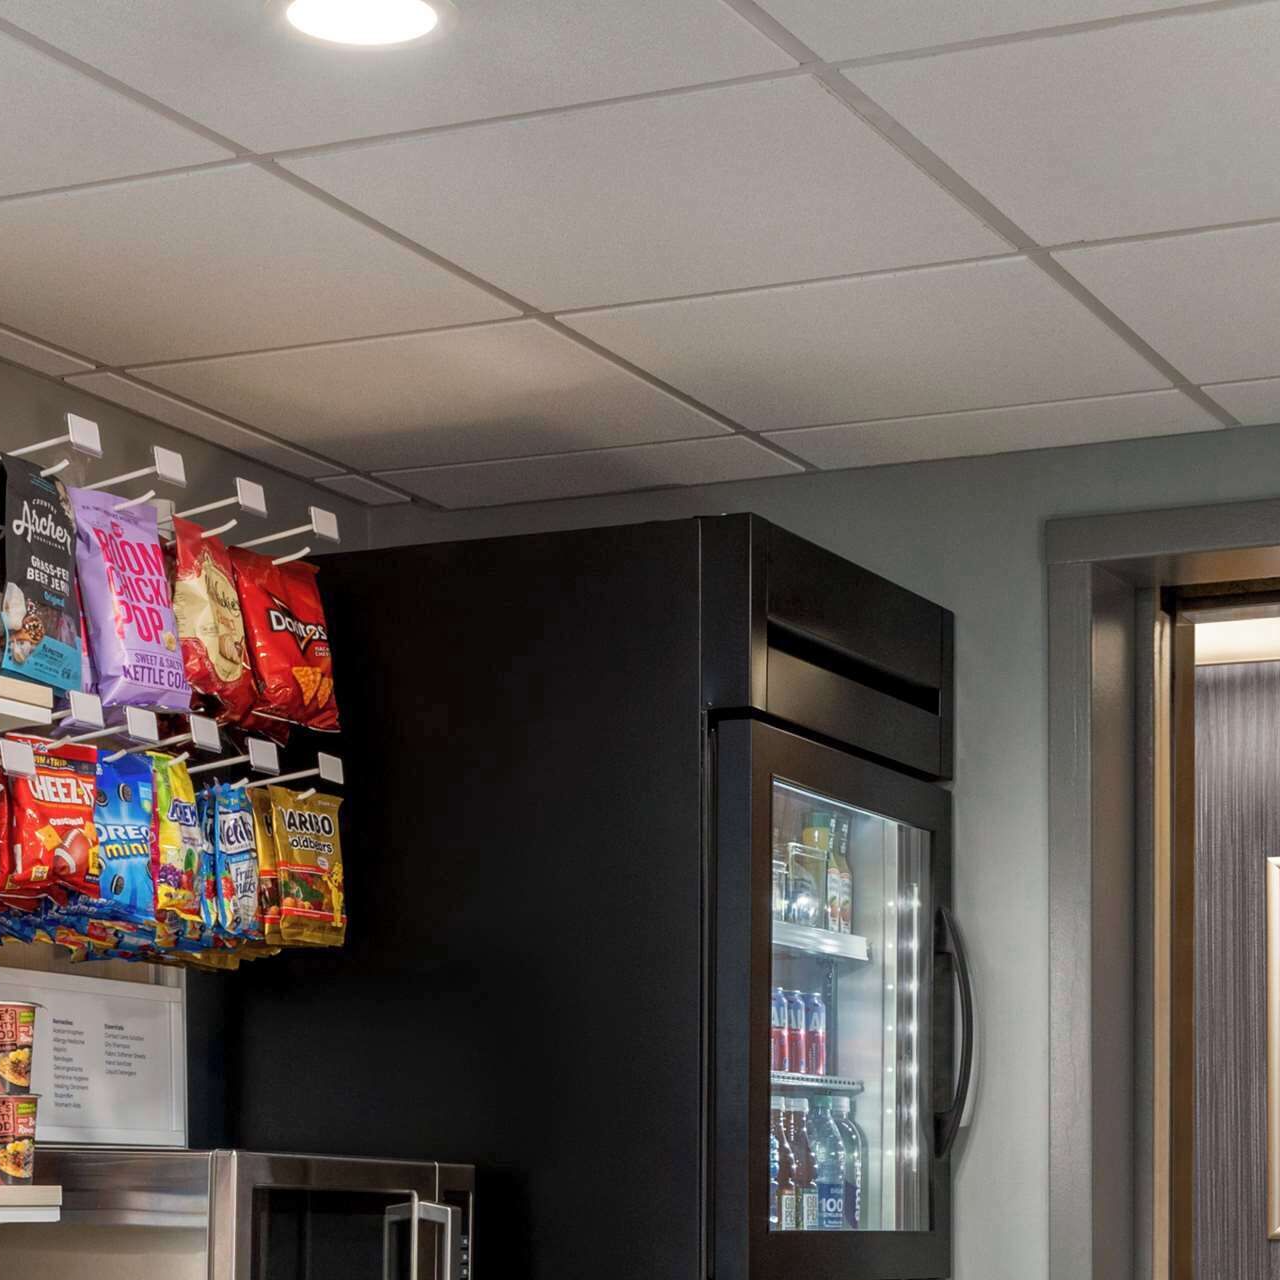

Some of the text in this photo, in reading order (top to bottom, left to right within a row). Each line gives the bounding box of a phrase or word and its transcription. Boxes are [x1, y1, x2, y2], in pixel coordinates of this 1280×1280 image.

[93, 527, 167, 577] BOOM
[114, 600, 164, 645] POP
[269, 610, 328, 640] Doritos
[122, 664, 166, 687] KETTLE
